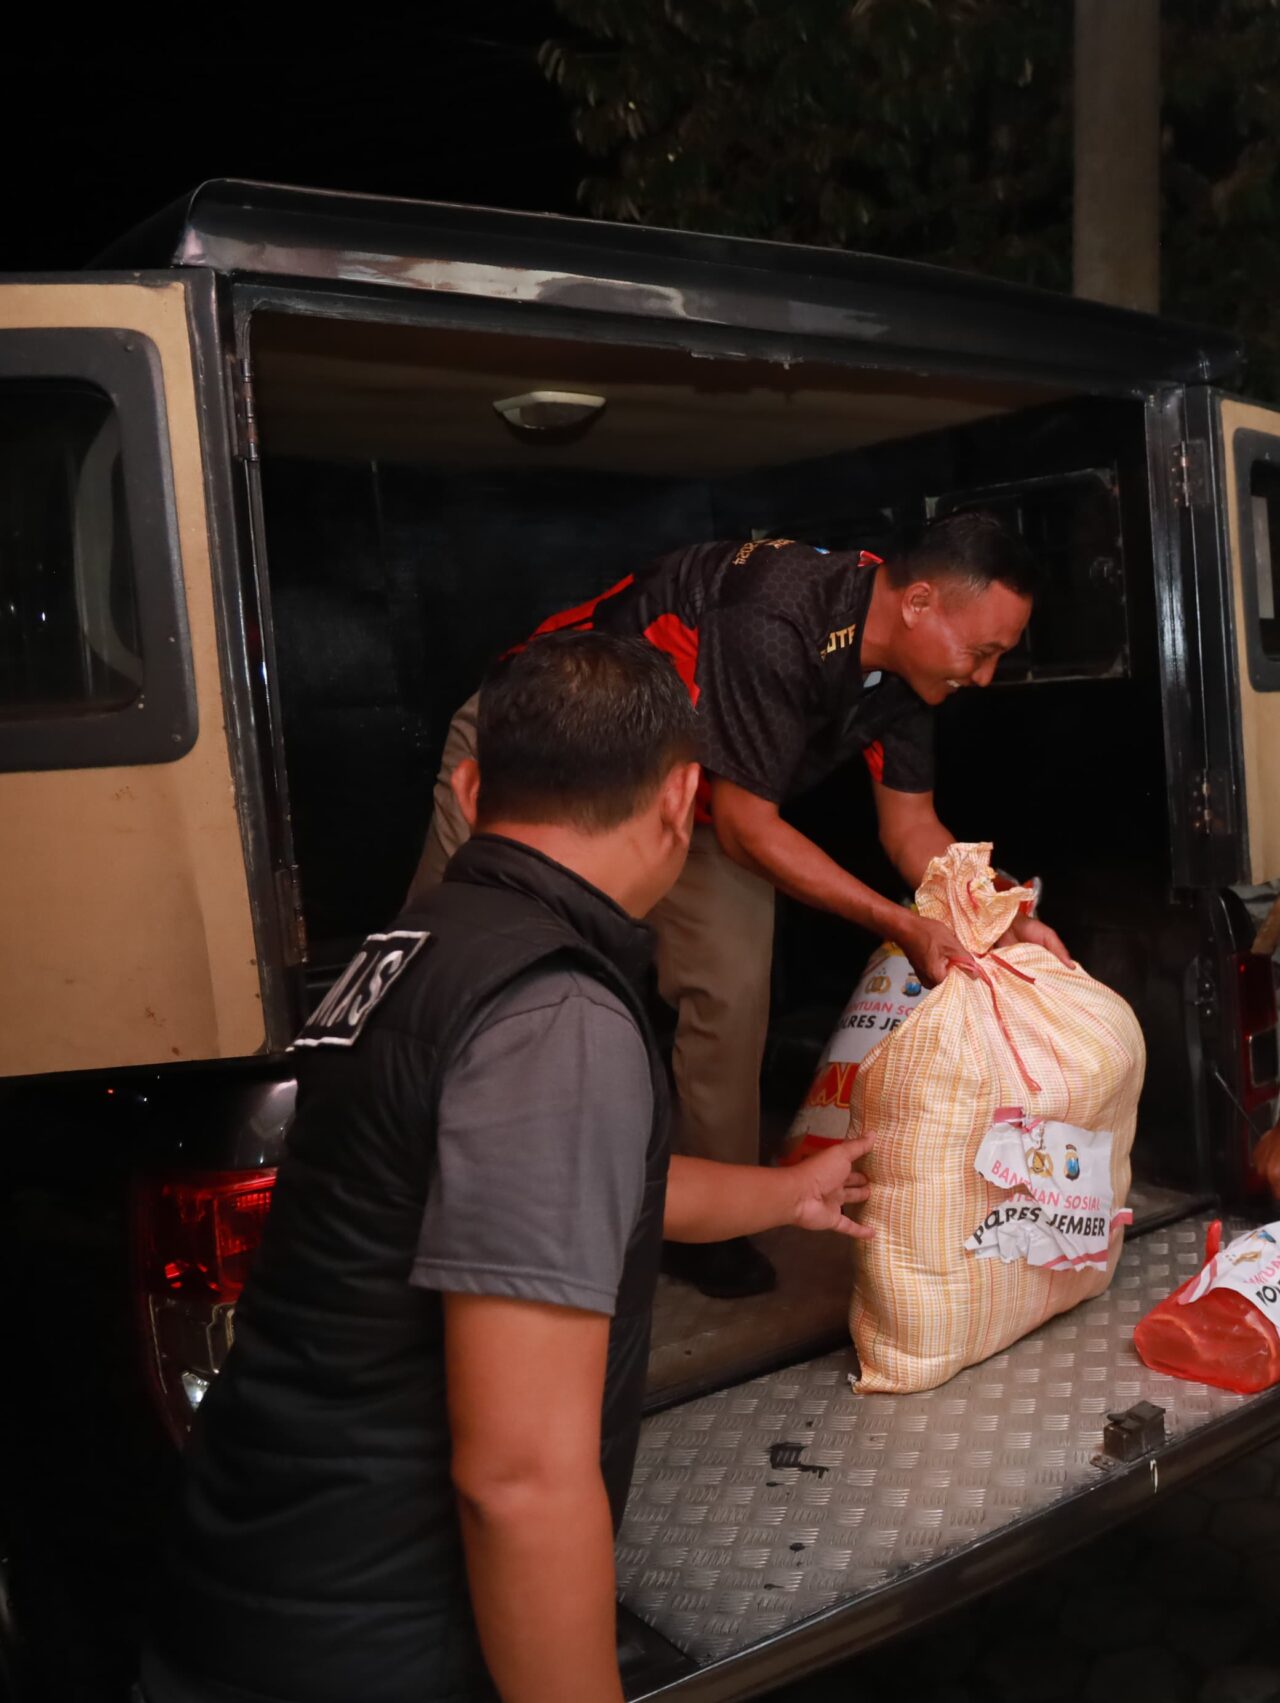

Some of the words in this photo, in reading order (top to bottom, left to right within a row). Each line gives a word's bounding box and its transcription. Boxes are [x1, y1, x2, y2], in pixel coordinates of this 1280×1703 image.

[1064, 1195, 1101, 1212] SOSIAL
[973, 1207, 1042, 1245] POLRES
[1046, 1214, 1106, 1237] JEMBER
